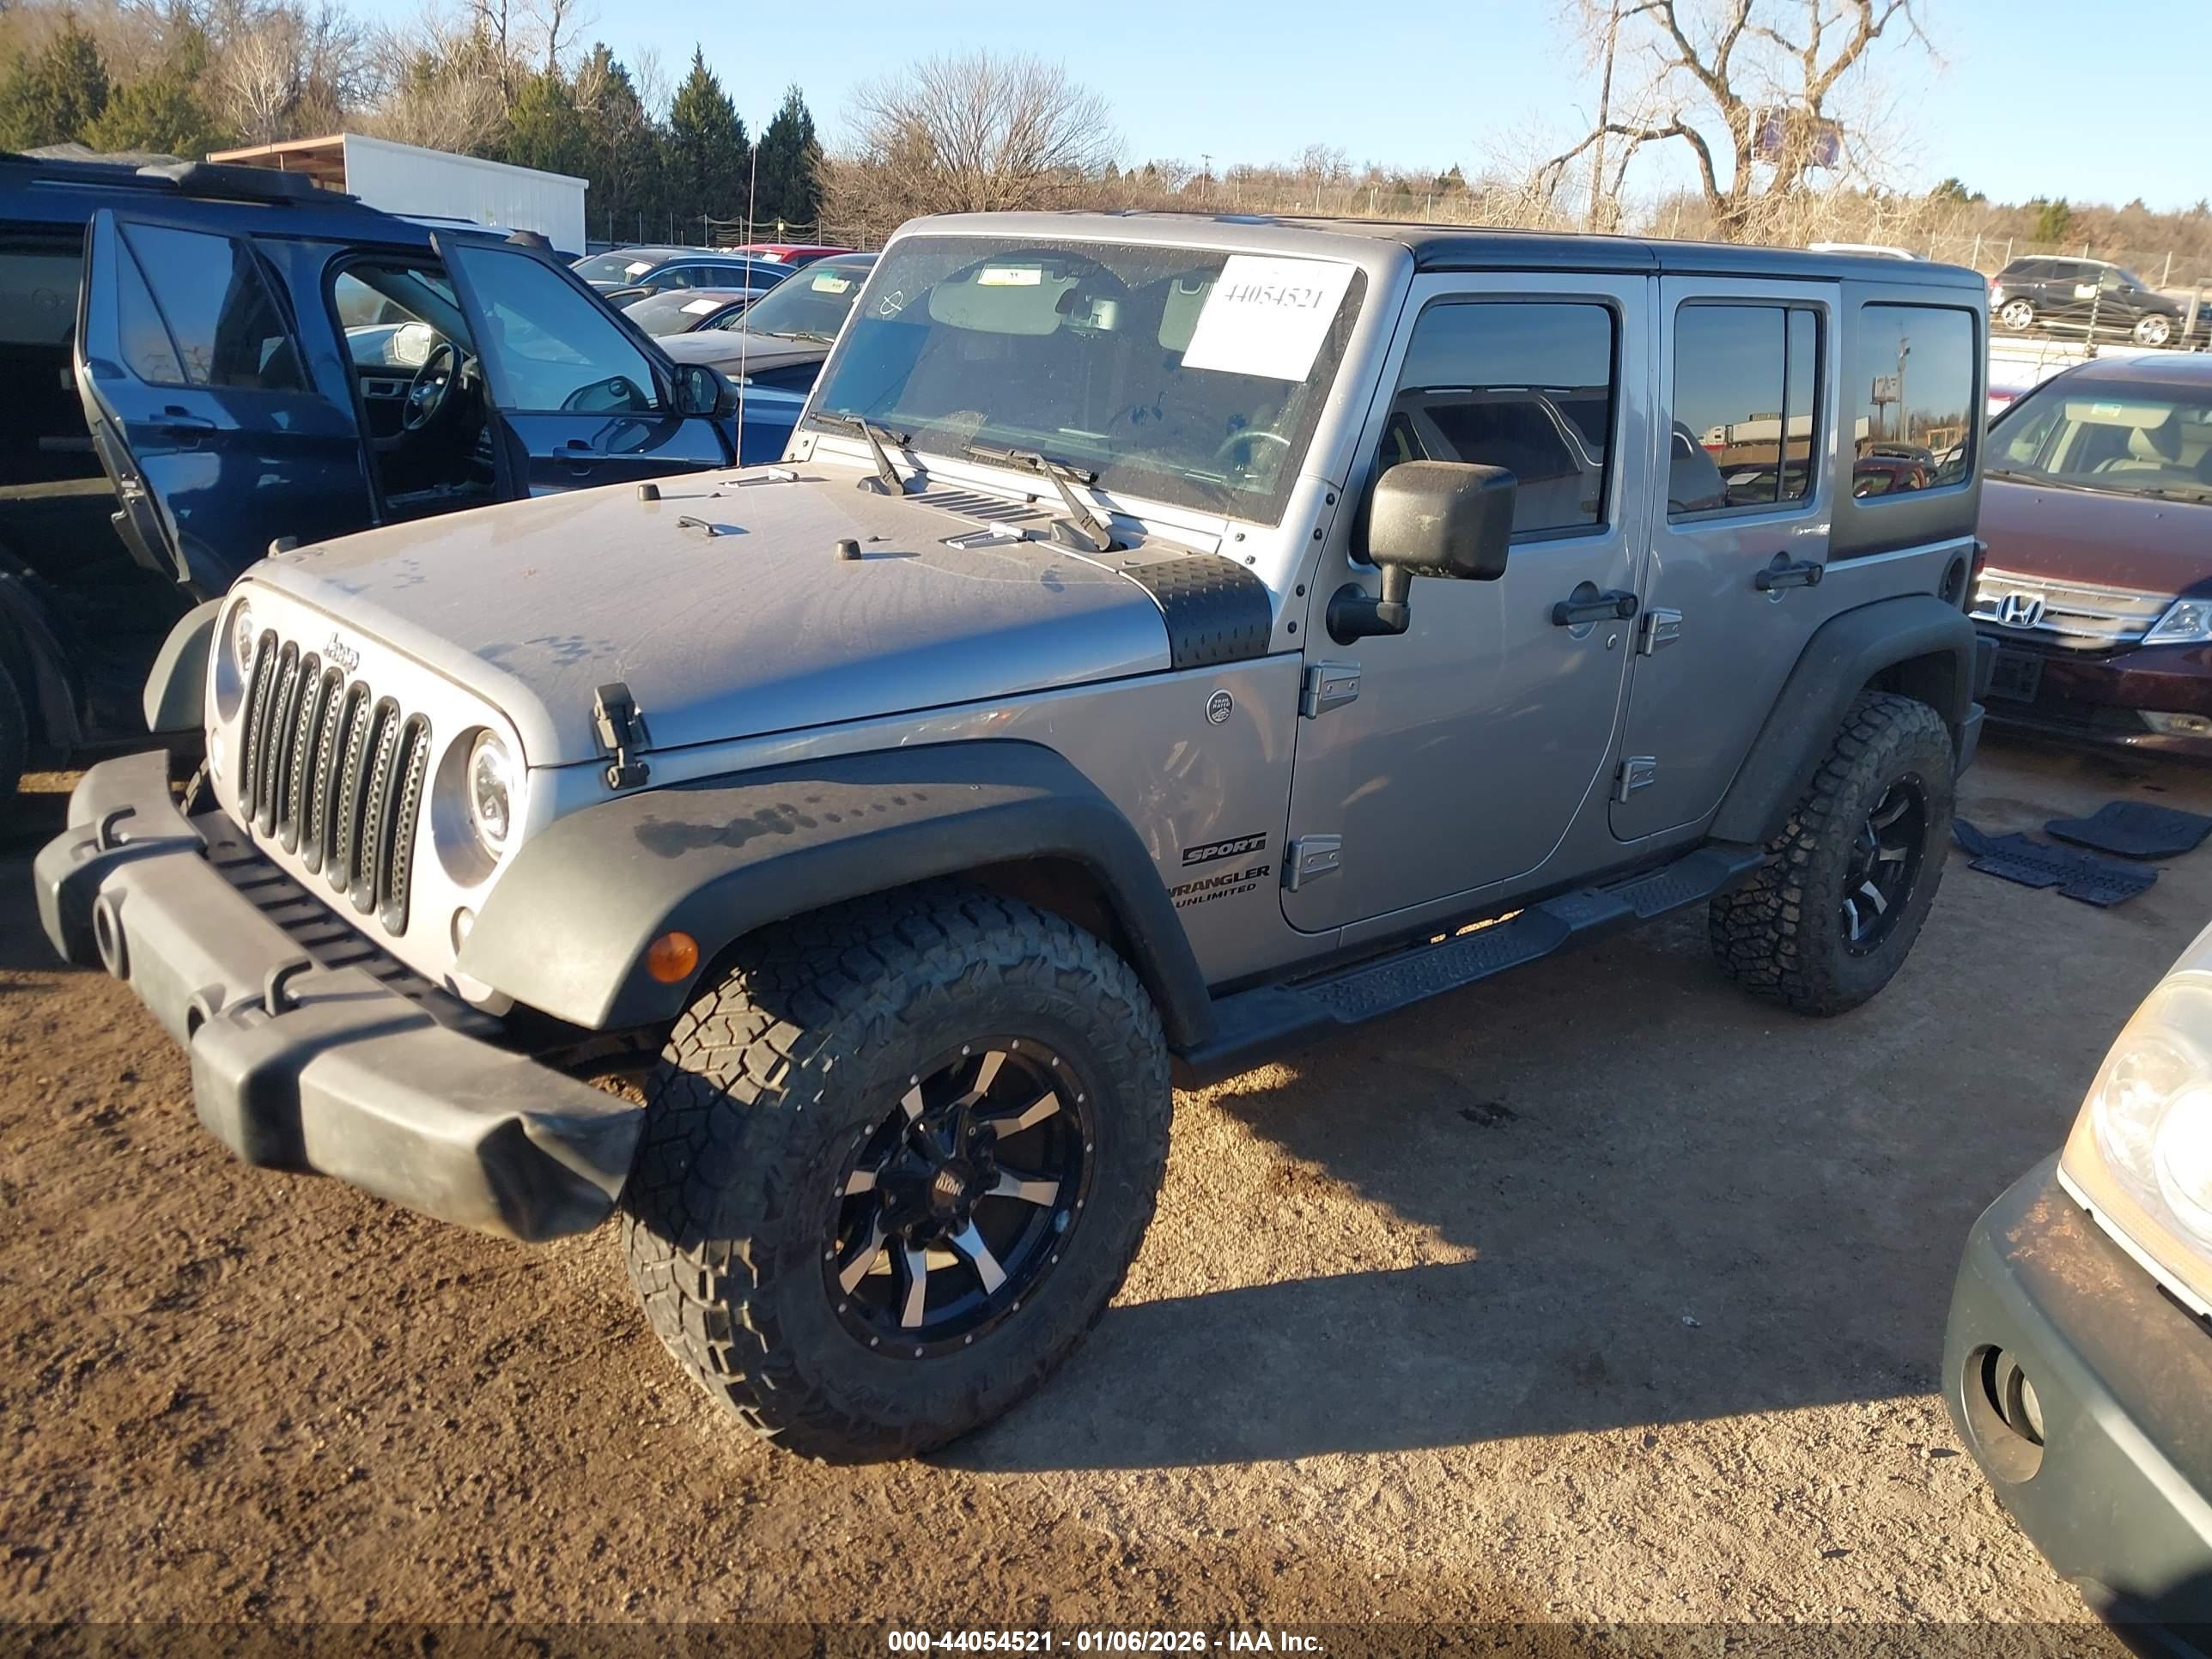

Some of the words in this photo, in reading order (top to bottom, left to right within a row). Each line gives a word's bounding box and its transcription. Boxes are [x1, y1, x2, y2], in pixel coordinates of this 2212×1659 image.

[1224, 283, 1323, 309] 44054521
[1187, 836, 1262, 862] SPORT
[1176, 883, 1257, 908] UNLIMITED
